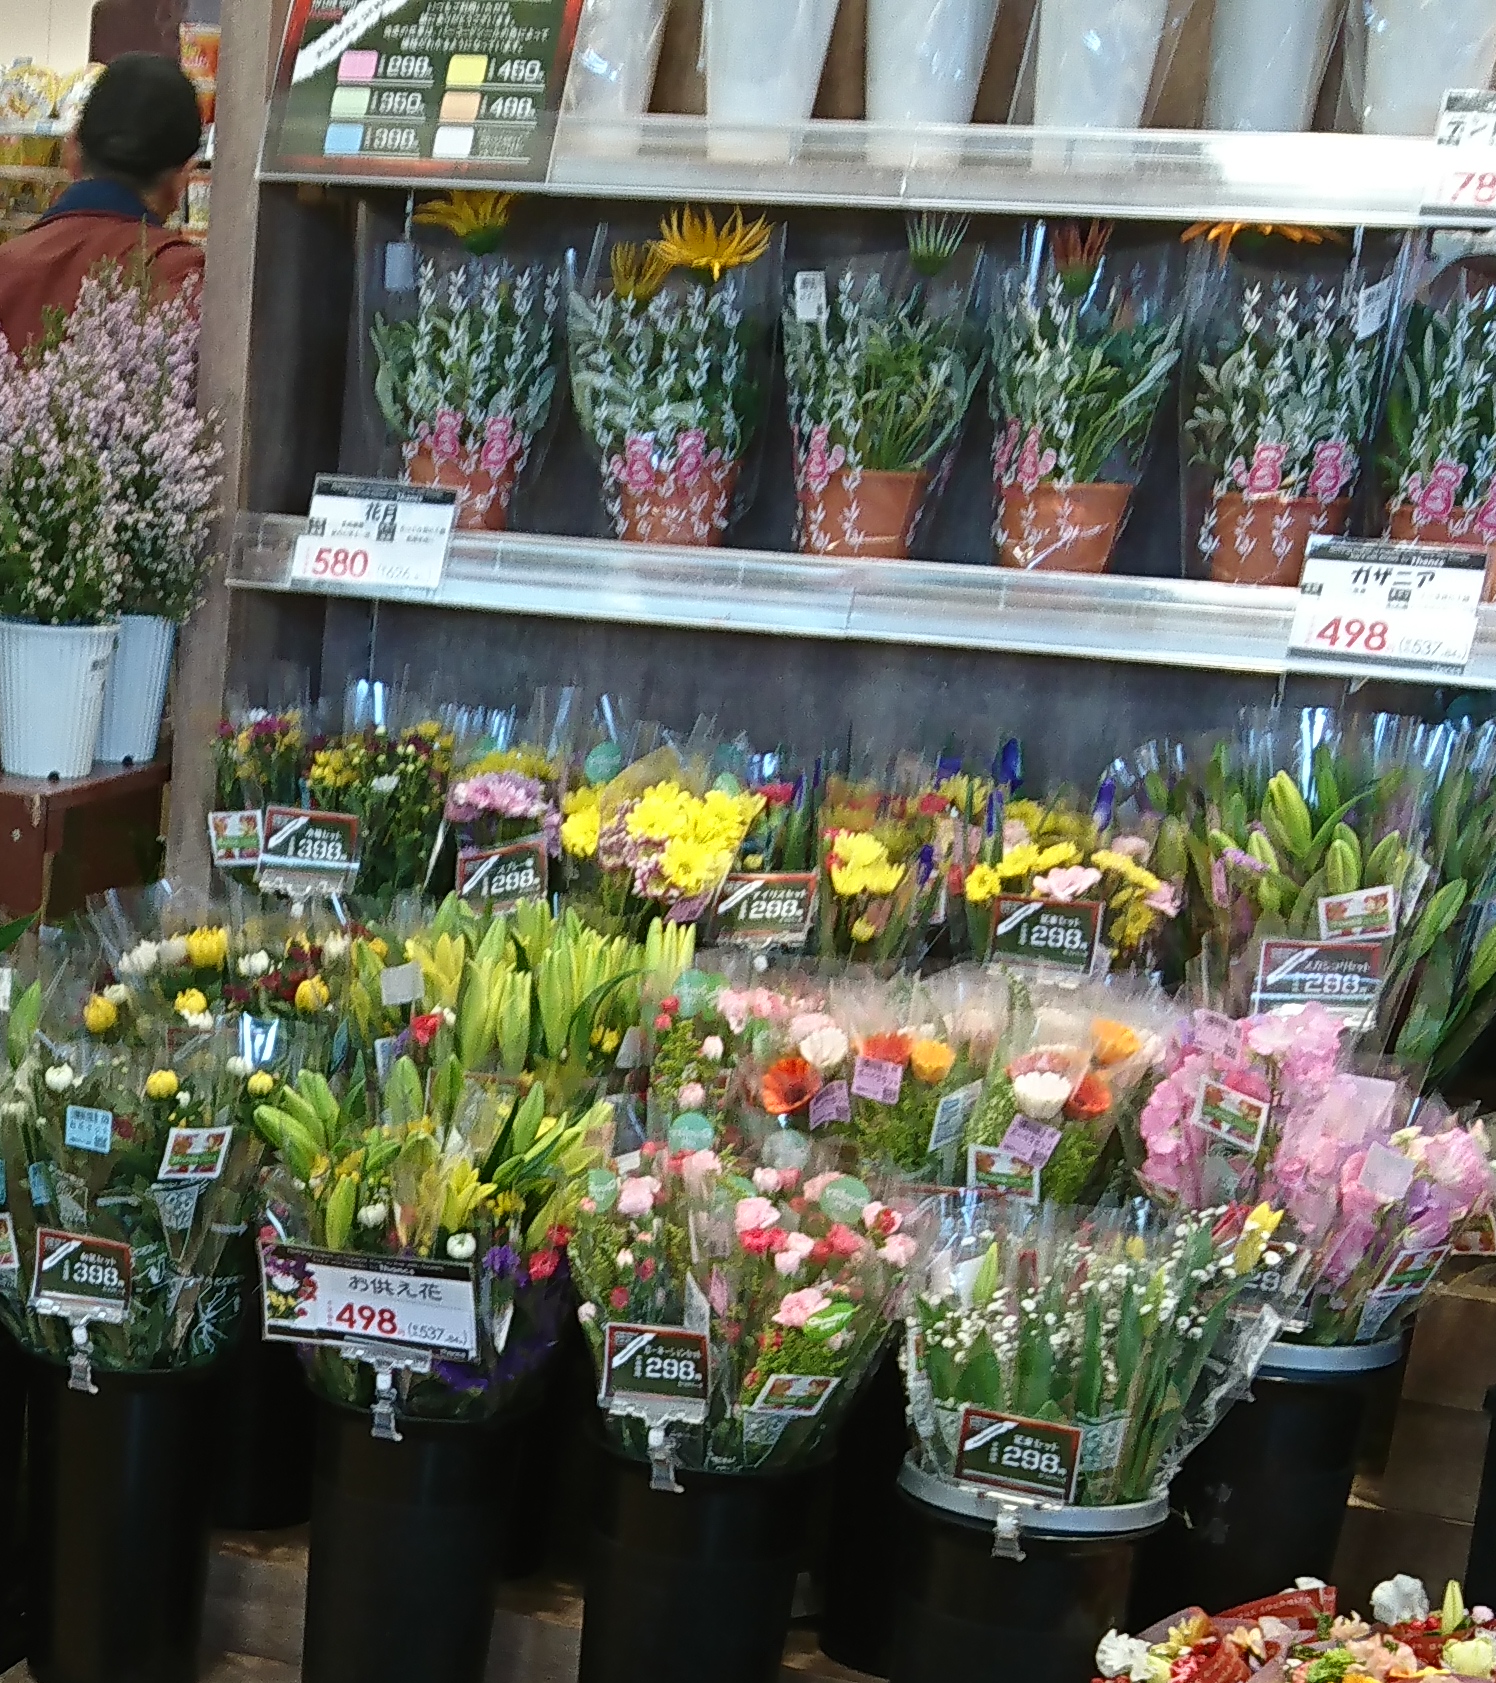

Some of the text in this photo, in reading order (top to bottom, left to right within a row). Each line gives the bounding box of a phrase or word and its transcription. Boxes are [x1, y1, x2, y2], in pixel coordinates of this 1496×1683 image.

[312, 546, 369, 578] 580
[1351, 565, 1436, 589] ガザニア
[1315, 615, 1389, 652] 498
[335, 1302, 399, 1335] 498
